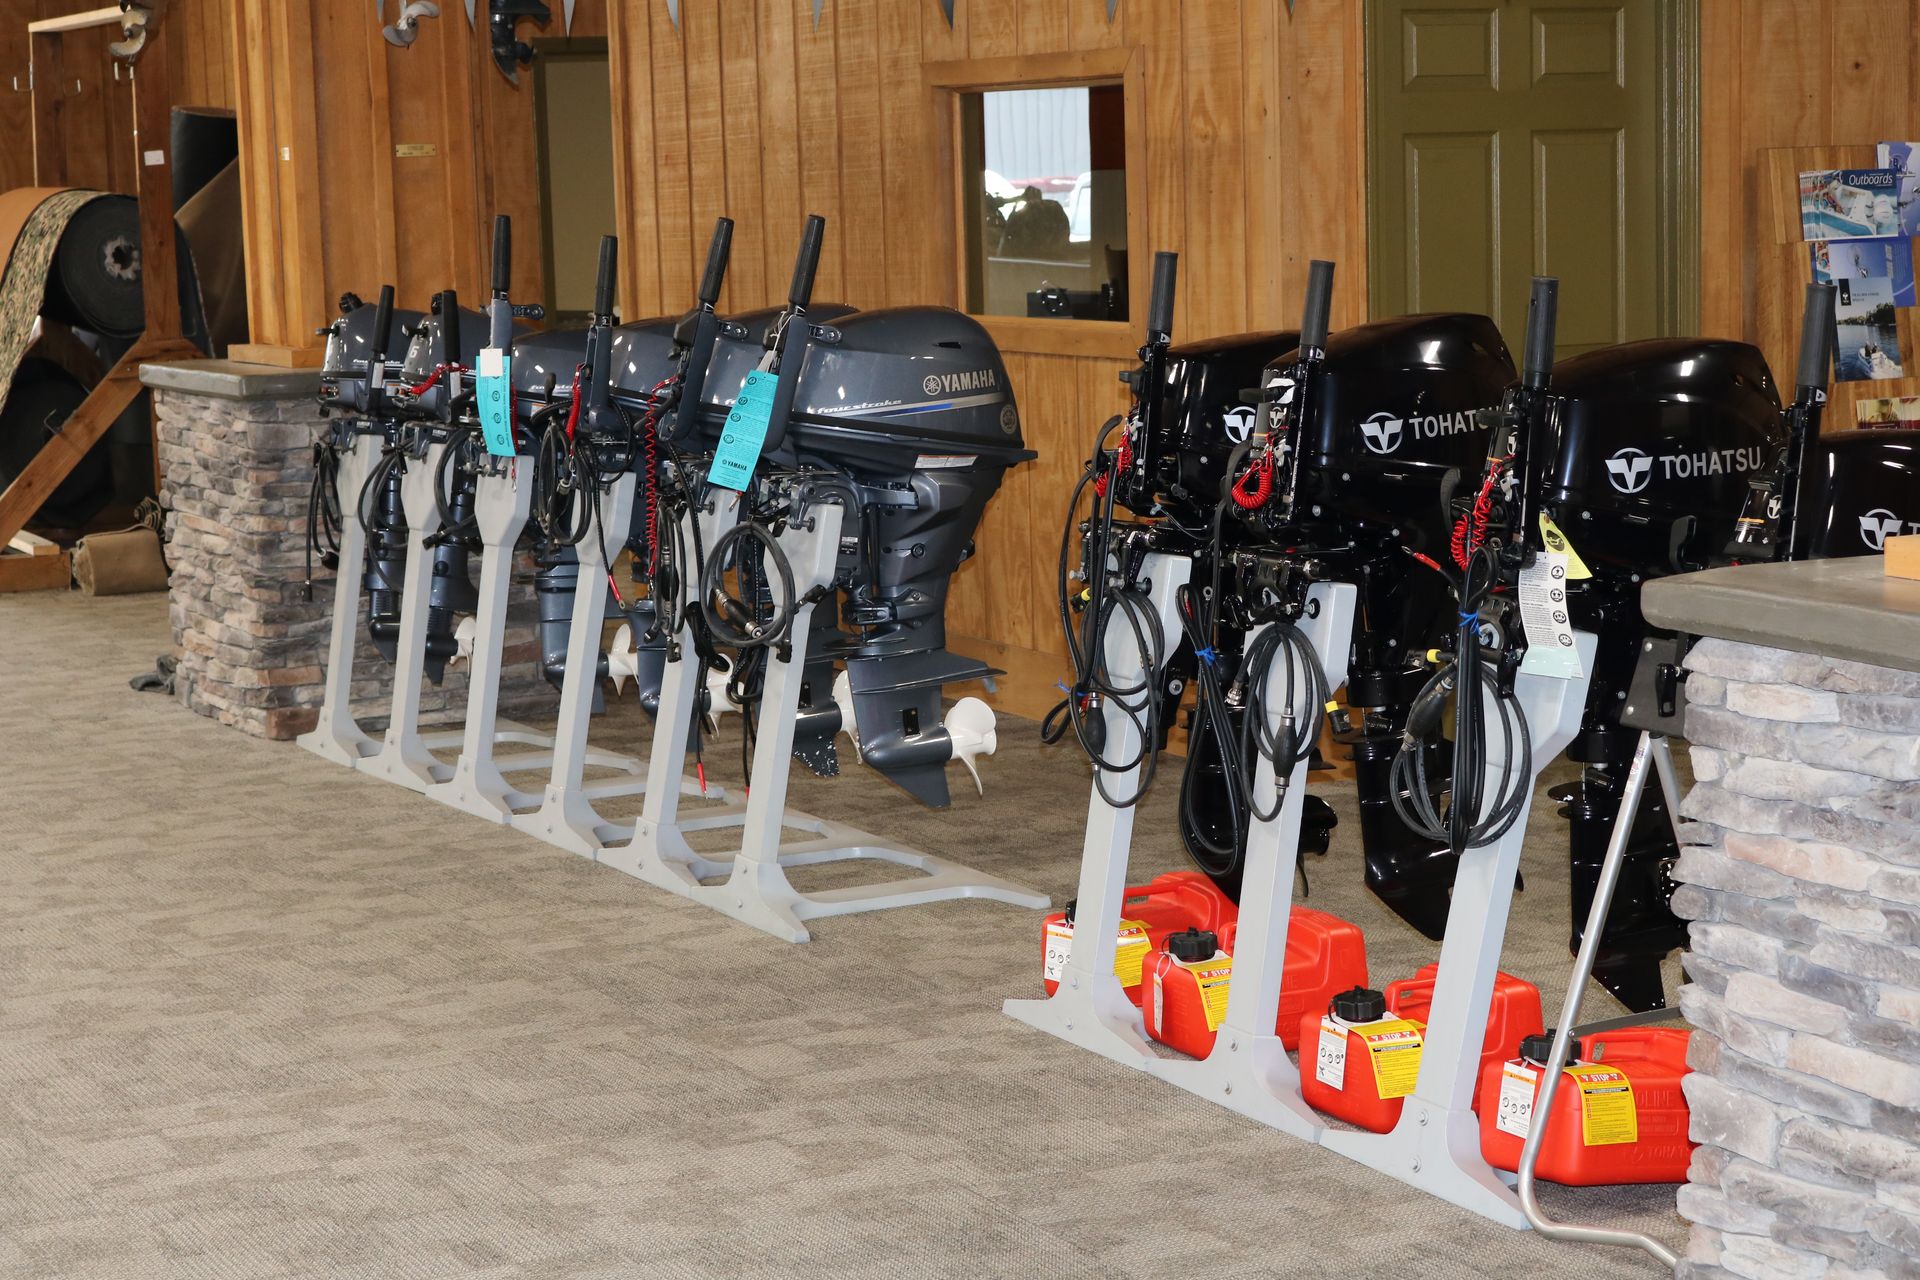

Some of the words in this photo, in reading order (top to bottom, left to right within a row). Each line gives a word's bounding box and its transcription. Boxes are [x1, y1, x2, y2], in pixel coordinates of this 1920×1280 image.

[1848, 173, 1893, 186] Outboards
[409, 346, 420, 358] 6
[942, 369, 995, 393] YAMAHA
[817, 399, 901, 414] fourstroke
[1409, 406, 1498, 440] TOHAT
[728, 460, 748, 471] YAMAHA
[1659, 447, 1761, 480] TOHATSU
[1211, 968, 1231, 977] STOP
[1381, 1032, 1402, 1041] STOP
[1591, 1074, 1610, 1082] STOP
[1635, 1089, 1673, 1107] OLINE
